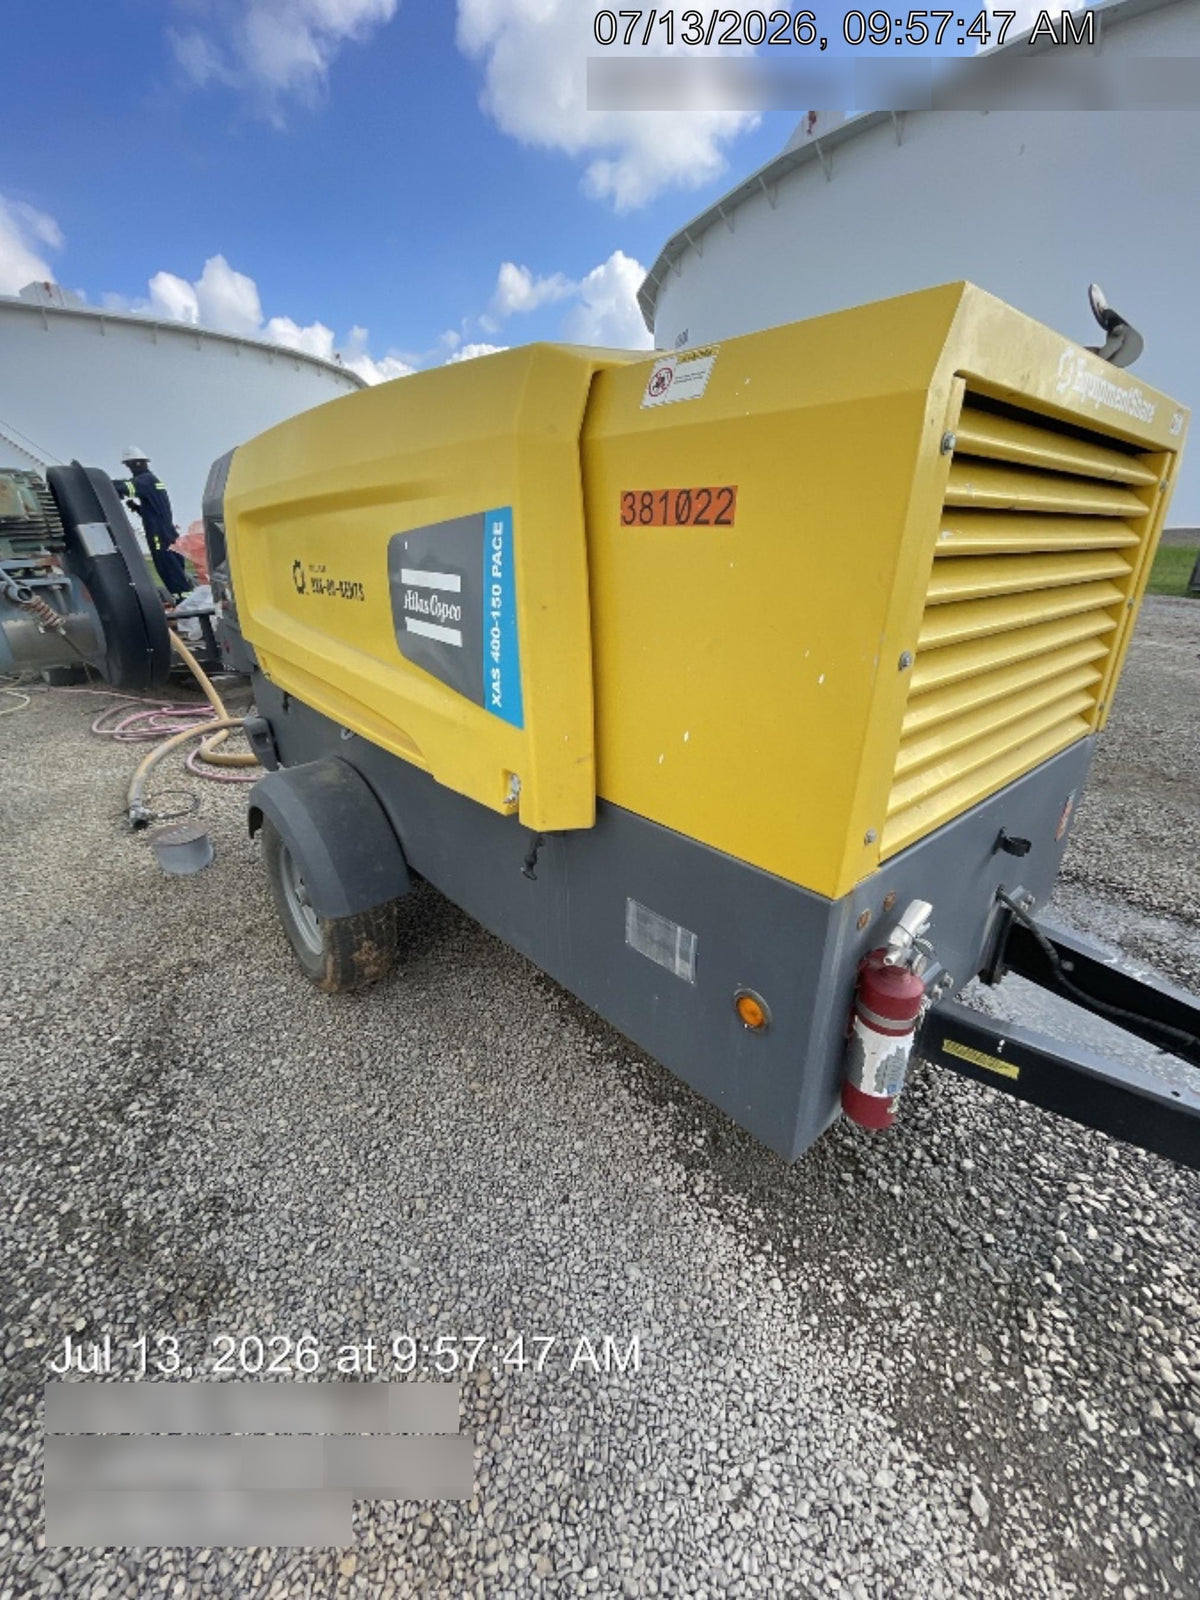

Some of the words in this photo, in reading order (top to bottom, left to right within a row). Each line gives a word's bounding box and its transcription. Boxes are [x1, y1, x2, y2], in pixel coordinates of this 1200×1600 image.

[622, 487, 734, 525] 381022
[492, 521, 503, 578] PACE
[403, 590, 429, 614] Atlas
[430, 595, 461, 623] Copco
[490, 584, 502, 663] 400-150
[491, 667, 502, 708] XAS
